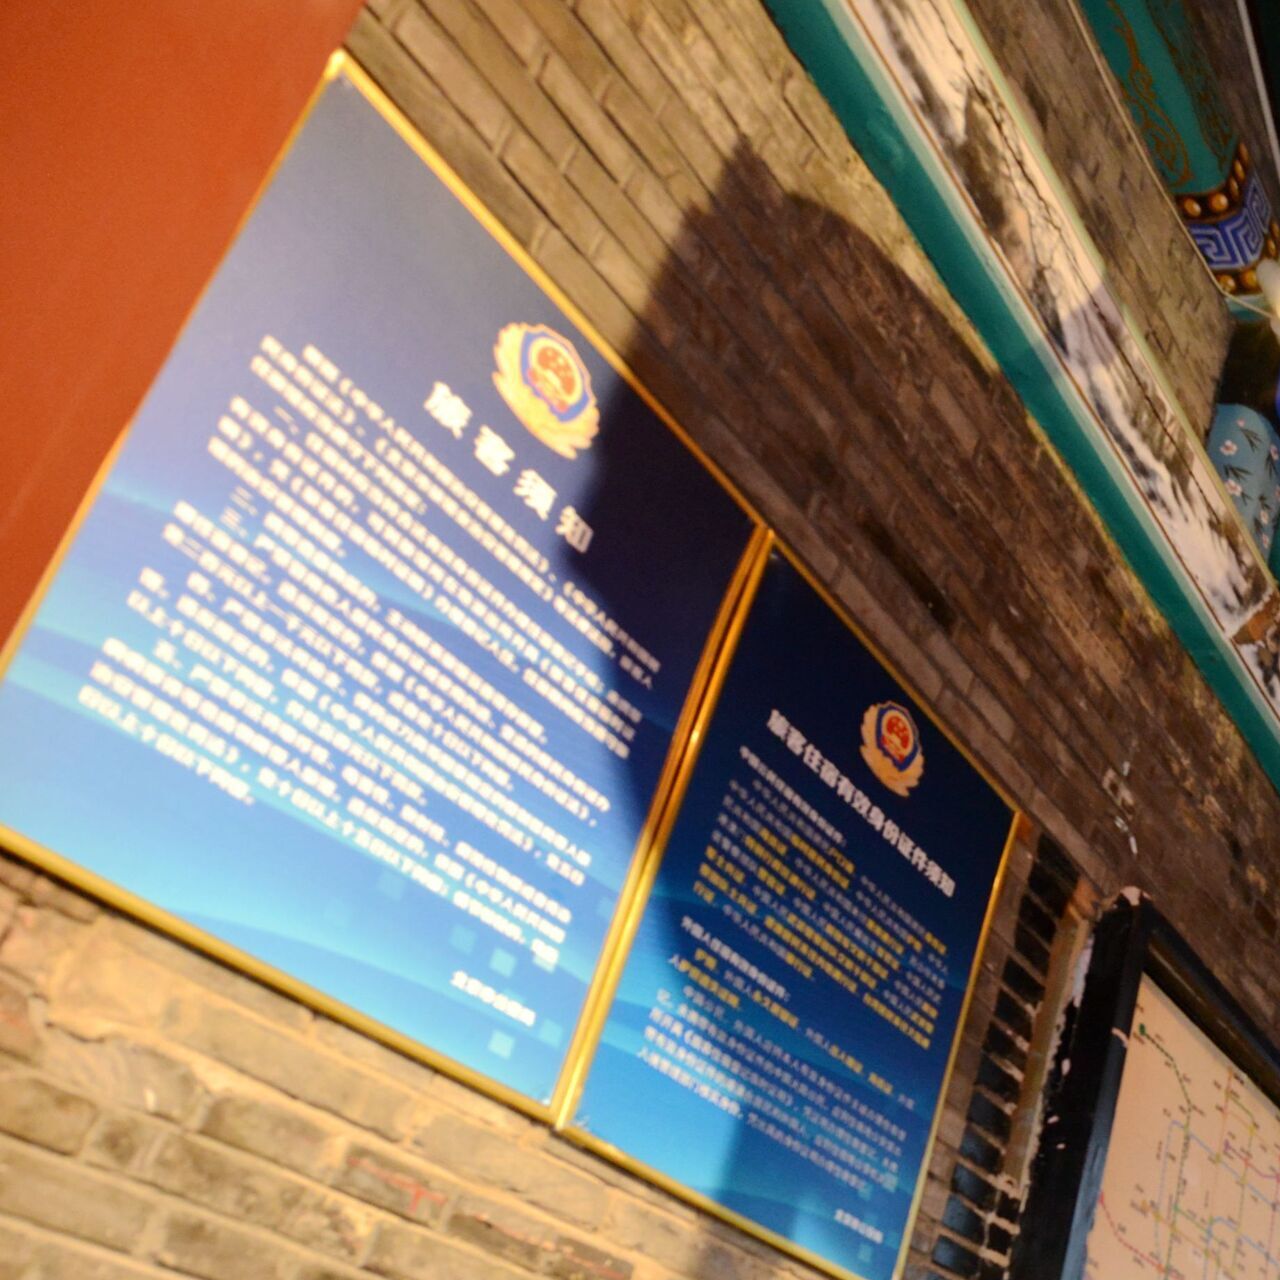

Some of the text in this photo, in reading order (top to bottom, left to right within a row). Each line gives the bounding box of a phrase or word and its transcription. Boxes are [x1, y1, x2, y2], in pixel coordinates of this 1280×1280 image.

[424, 380, 594, 554] 旅客须知
[766, 708, 956, 898] 旅客住宿有效身份证件须知
